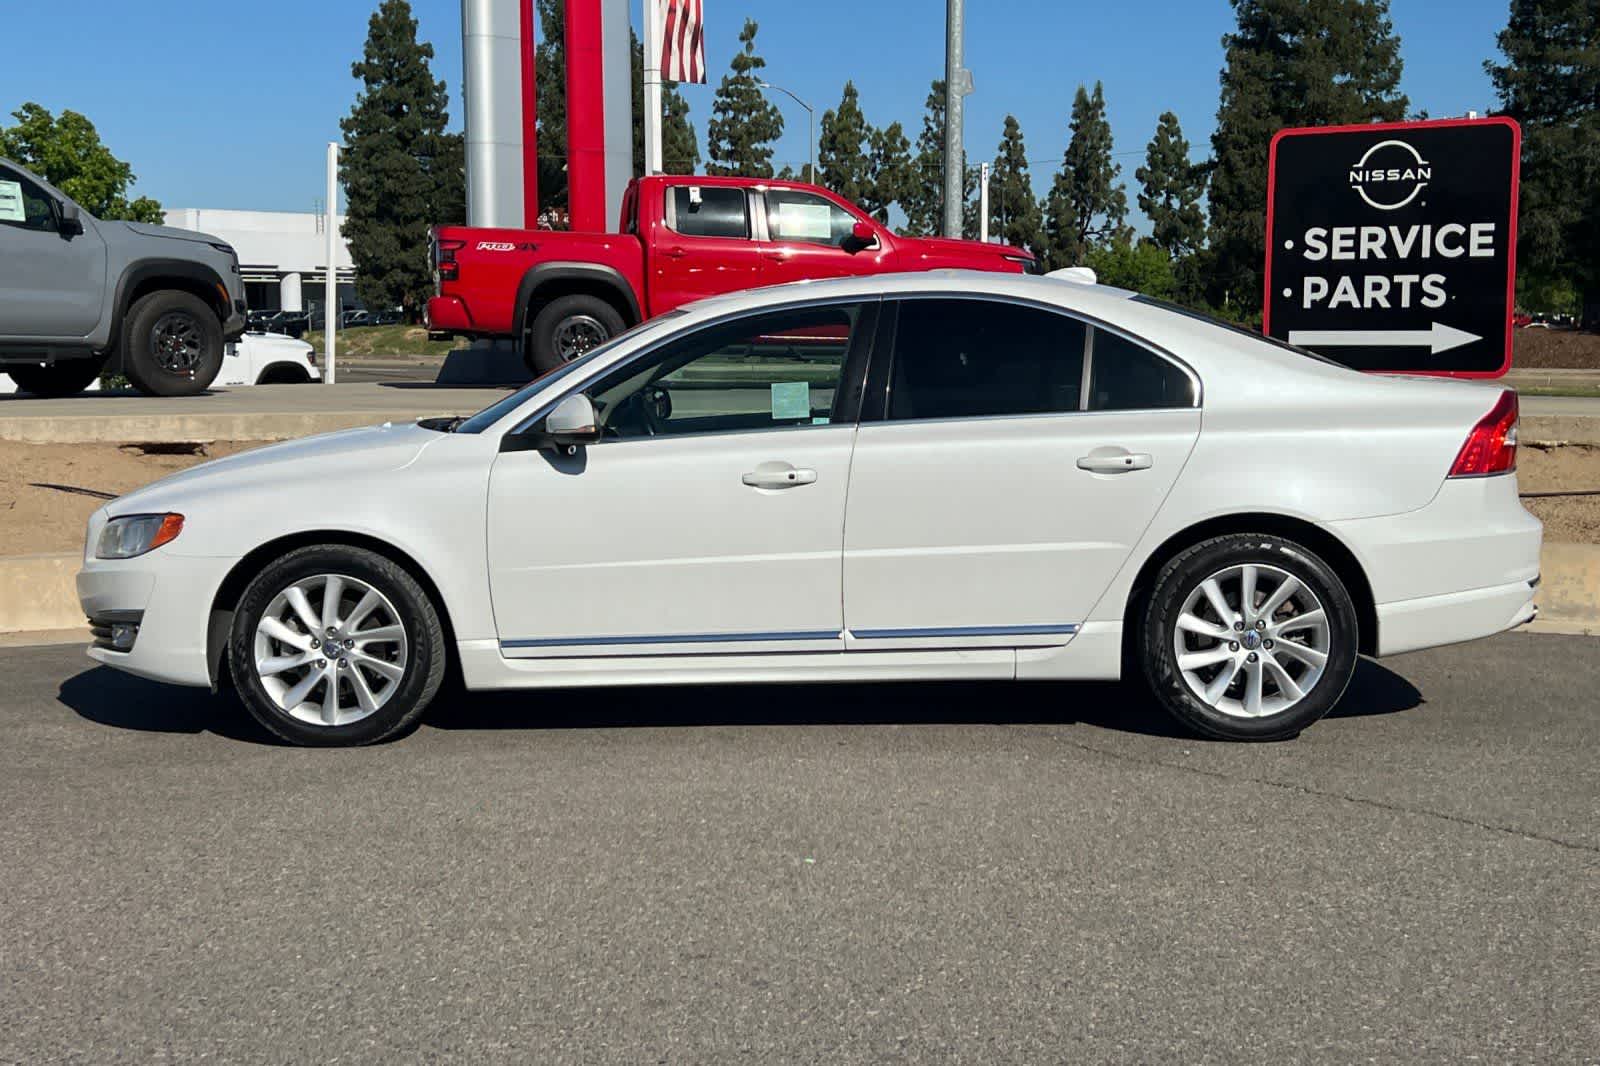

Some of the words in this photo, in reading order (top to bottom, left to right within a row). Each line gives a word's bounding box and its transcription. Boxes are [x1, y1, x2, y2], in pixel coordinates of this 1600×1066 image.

[1349, 167, 1432, 183] NISSAN
[1303, 222, 1496, 261] SERVICE
[1302, 273, 1447, 309] PARTS
